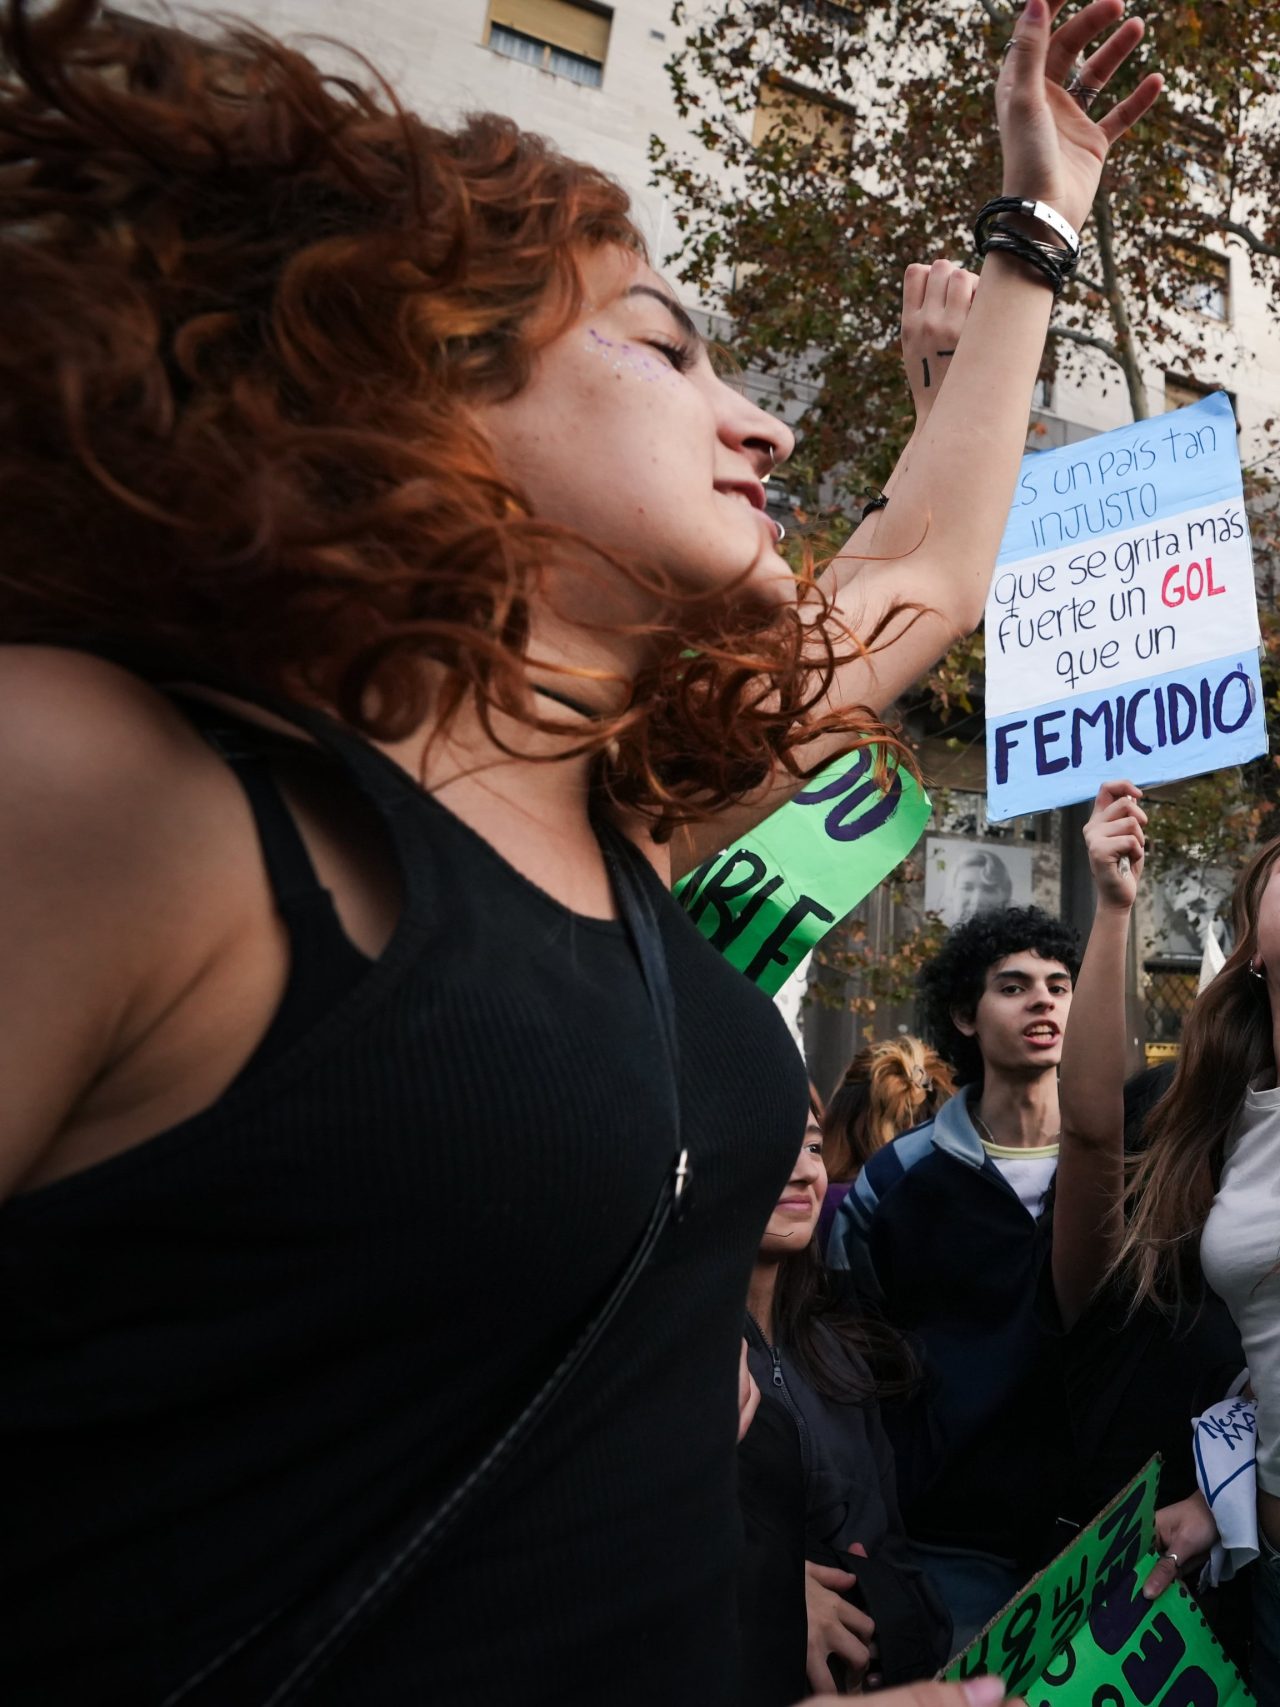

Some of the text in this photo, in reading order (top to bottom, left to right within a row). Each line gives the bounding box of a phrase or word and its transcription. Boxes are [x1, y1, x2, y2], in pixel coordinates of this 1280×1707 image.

[1053, 460, 1092, 495] un
[1098, 436, 1157, 485] país
[1161, 425, 1217, 463] tan
[994, 508, 1245, 619] que se grita más
[1109, 587, 1147, 622] un
[1160, 556, 1227, 608] GOL
[1056, 625, 1177, 690] que un
